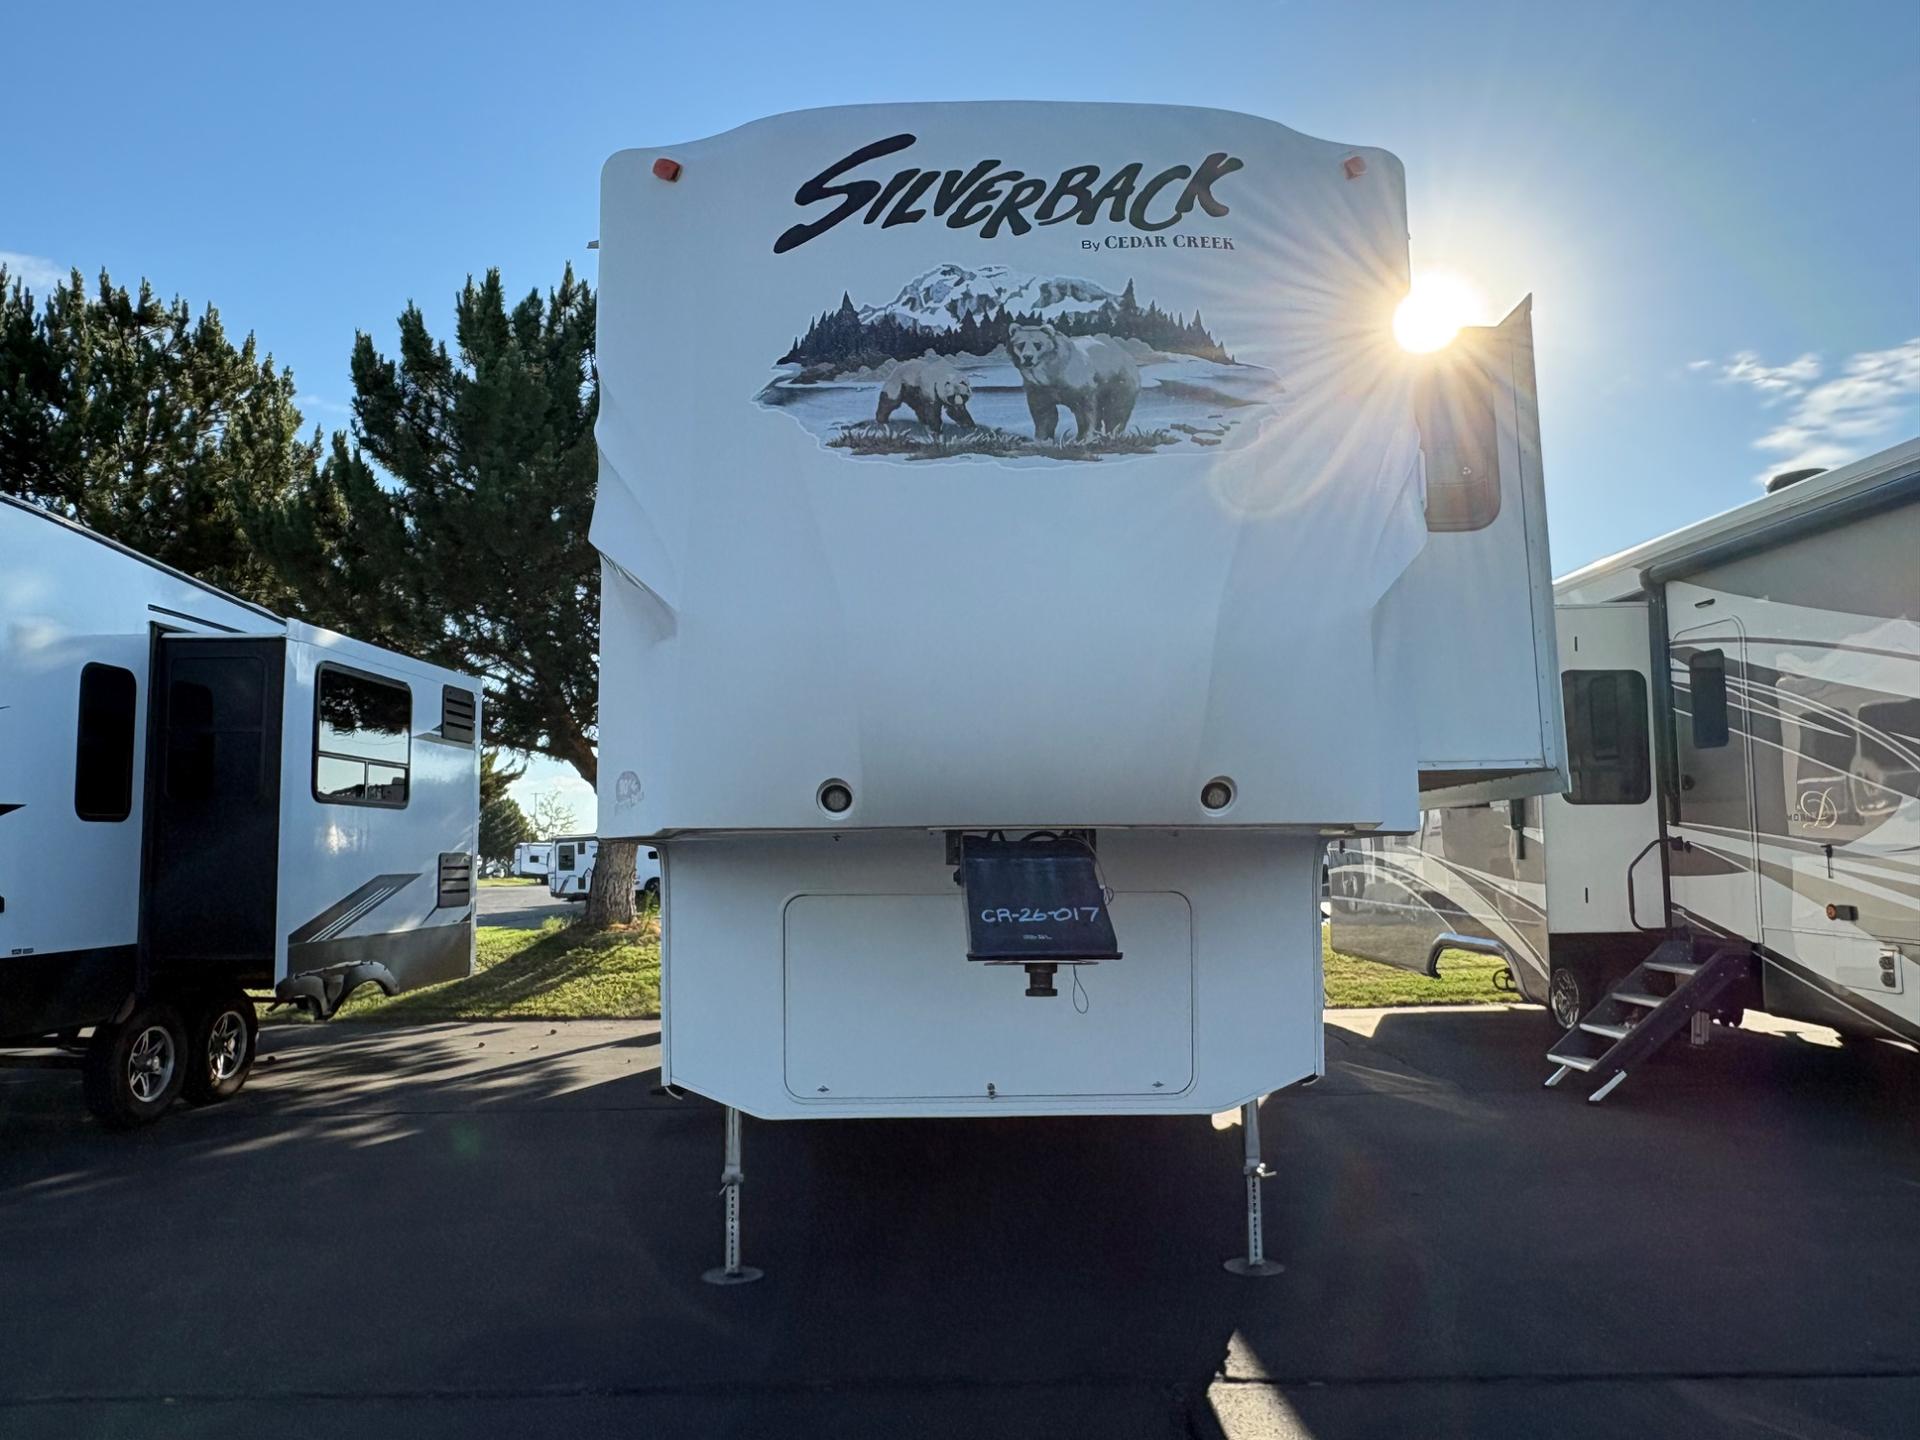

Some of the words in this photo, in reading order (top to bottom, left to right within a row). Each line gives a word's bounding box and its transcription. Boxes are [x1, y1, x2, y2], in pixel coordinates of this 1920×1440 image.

[774, 133, 1244, 254] SILVERBACK
[1081, 239, 1101, 251] By
[1104, 235, 1167, 249] CEDAR
[1172, 234, 1235, 250] CREEK
[1800, 786, 1837, 829] D
